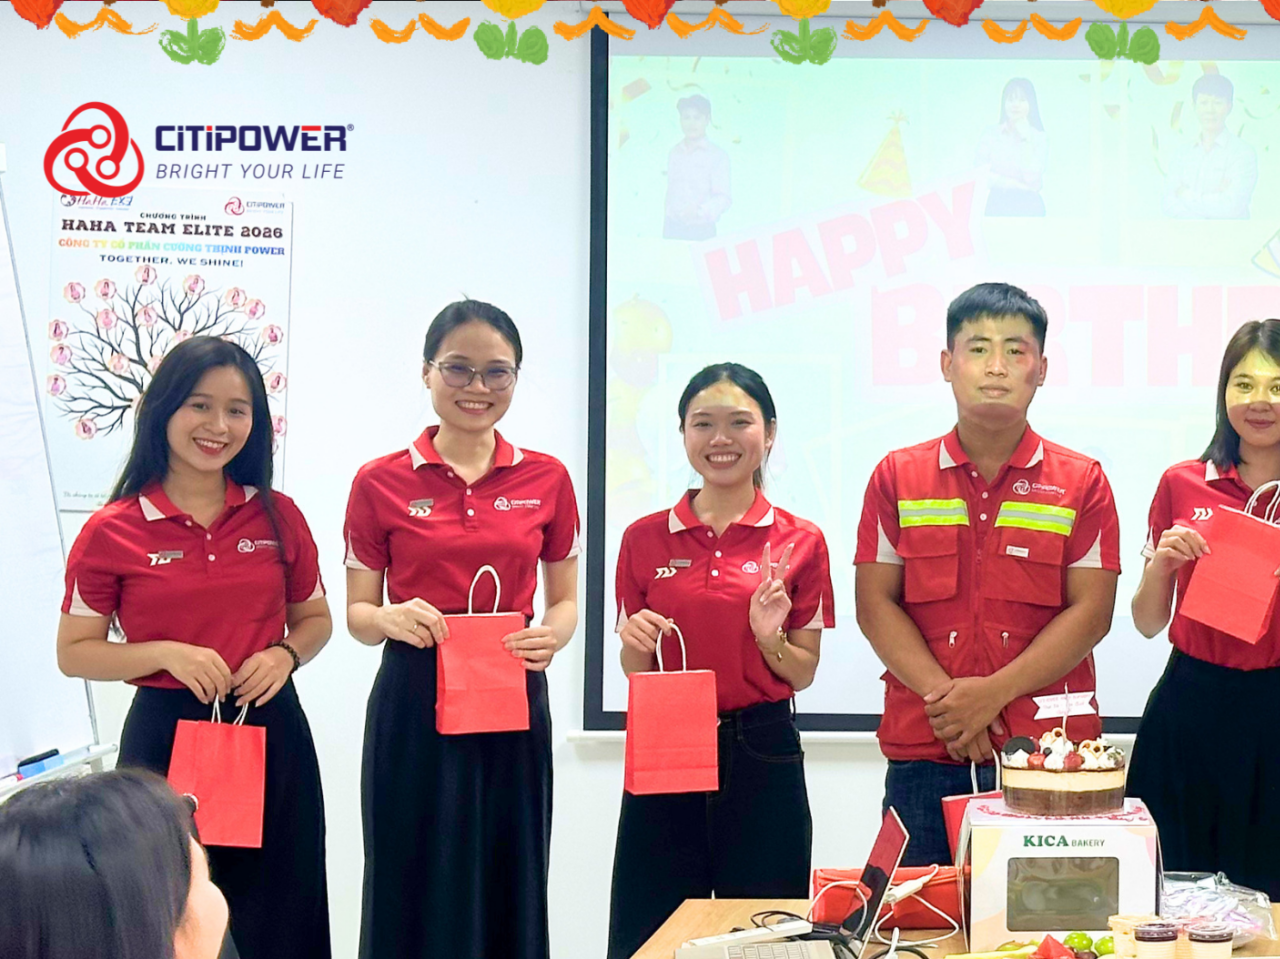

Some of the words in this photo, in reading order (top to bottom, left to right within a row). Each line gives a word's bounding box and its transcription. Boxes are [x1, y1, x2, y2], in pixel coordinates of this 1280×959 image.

[61, 219, 117, 232] HAHA
[124, 221, 176, 235] TEAM
[182, 223, 234, 237] ELITE
[240, 226, 283, 239] 2026
[58, 237, 90, 248] CÔNG
[92, 239, 108, 248] TY
[244, 245, 285, 255] POWER
[704, 180, 977, 322] HAPPY
[177, 257, 197, 265] WE
[200, 258, 243, 268] SHINE!
[1023, 835, 1069, 847] KICA
[1071, 839, 1105, 847] BAKERY
